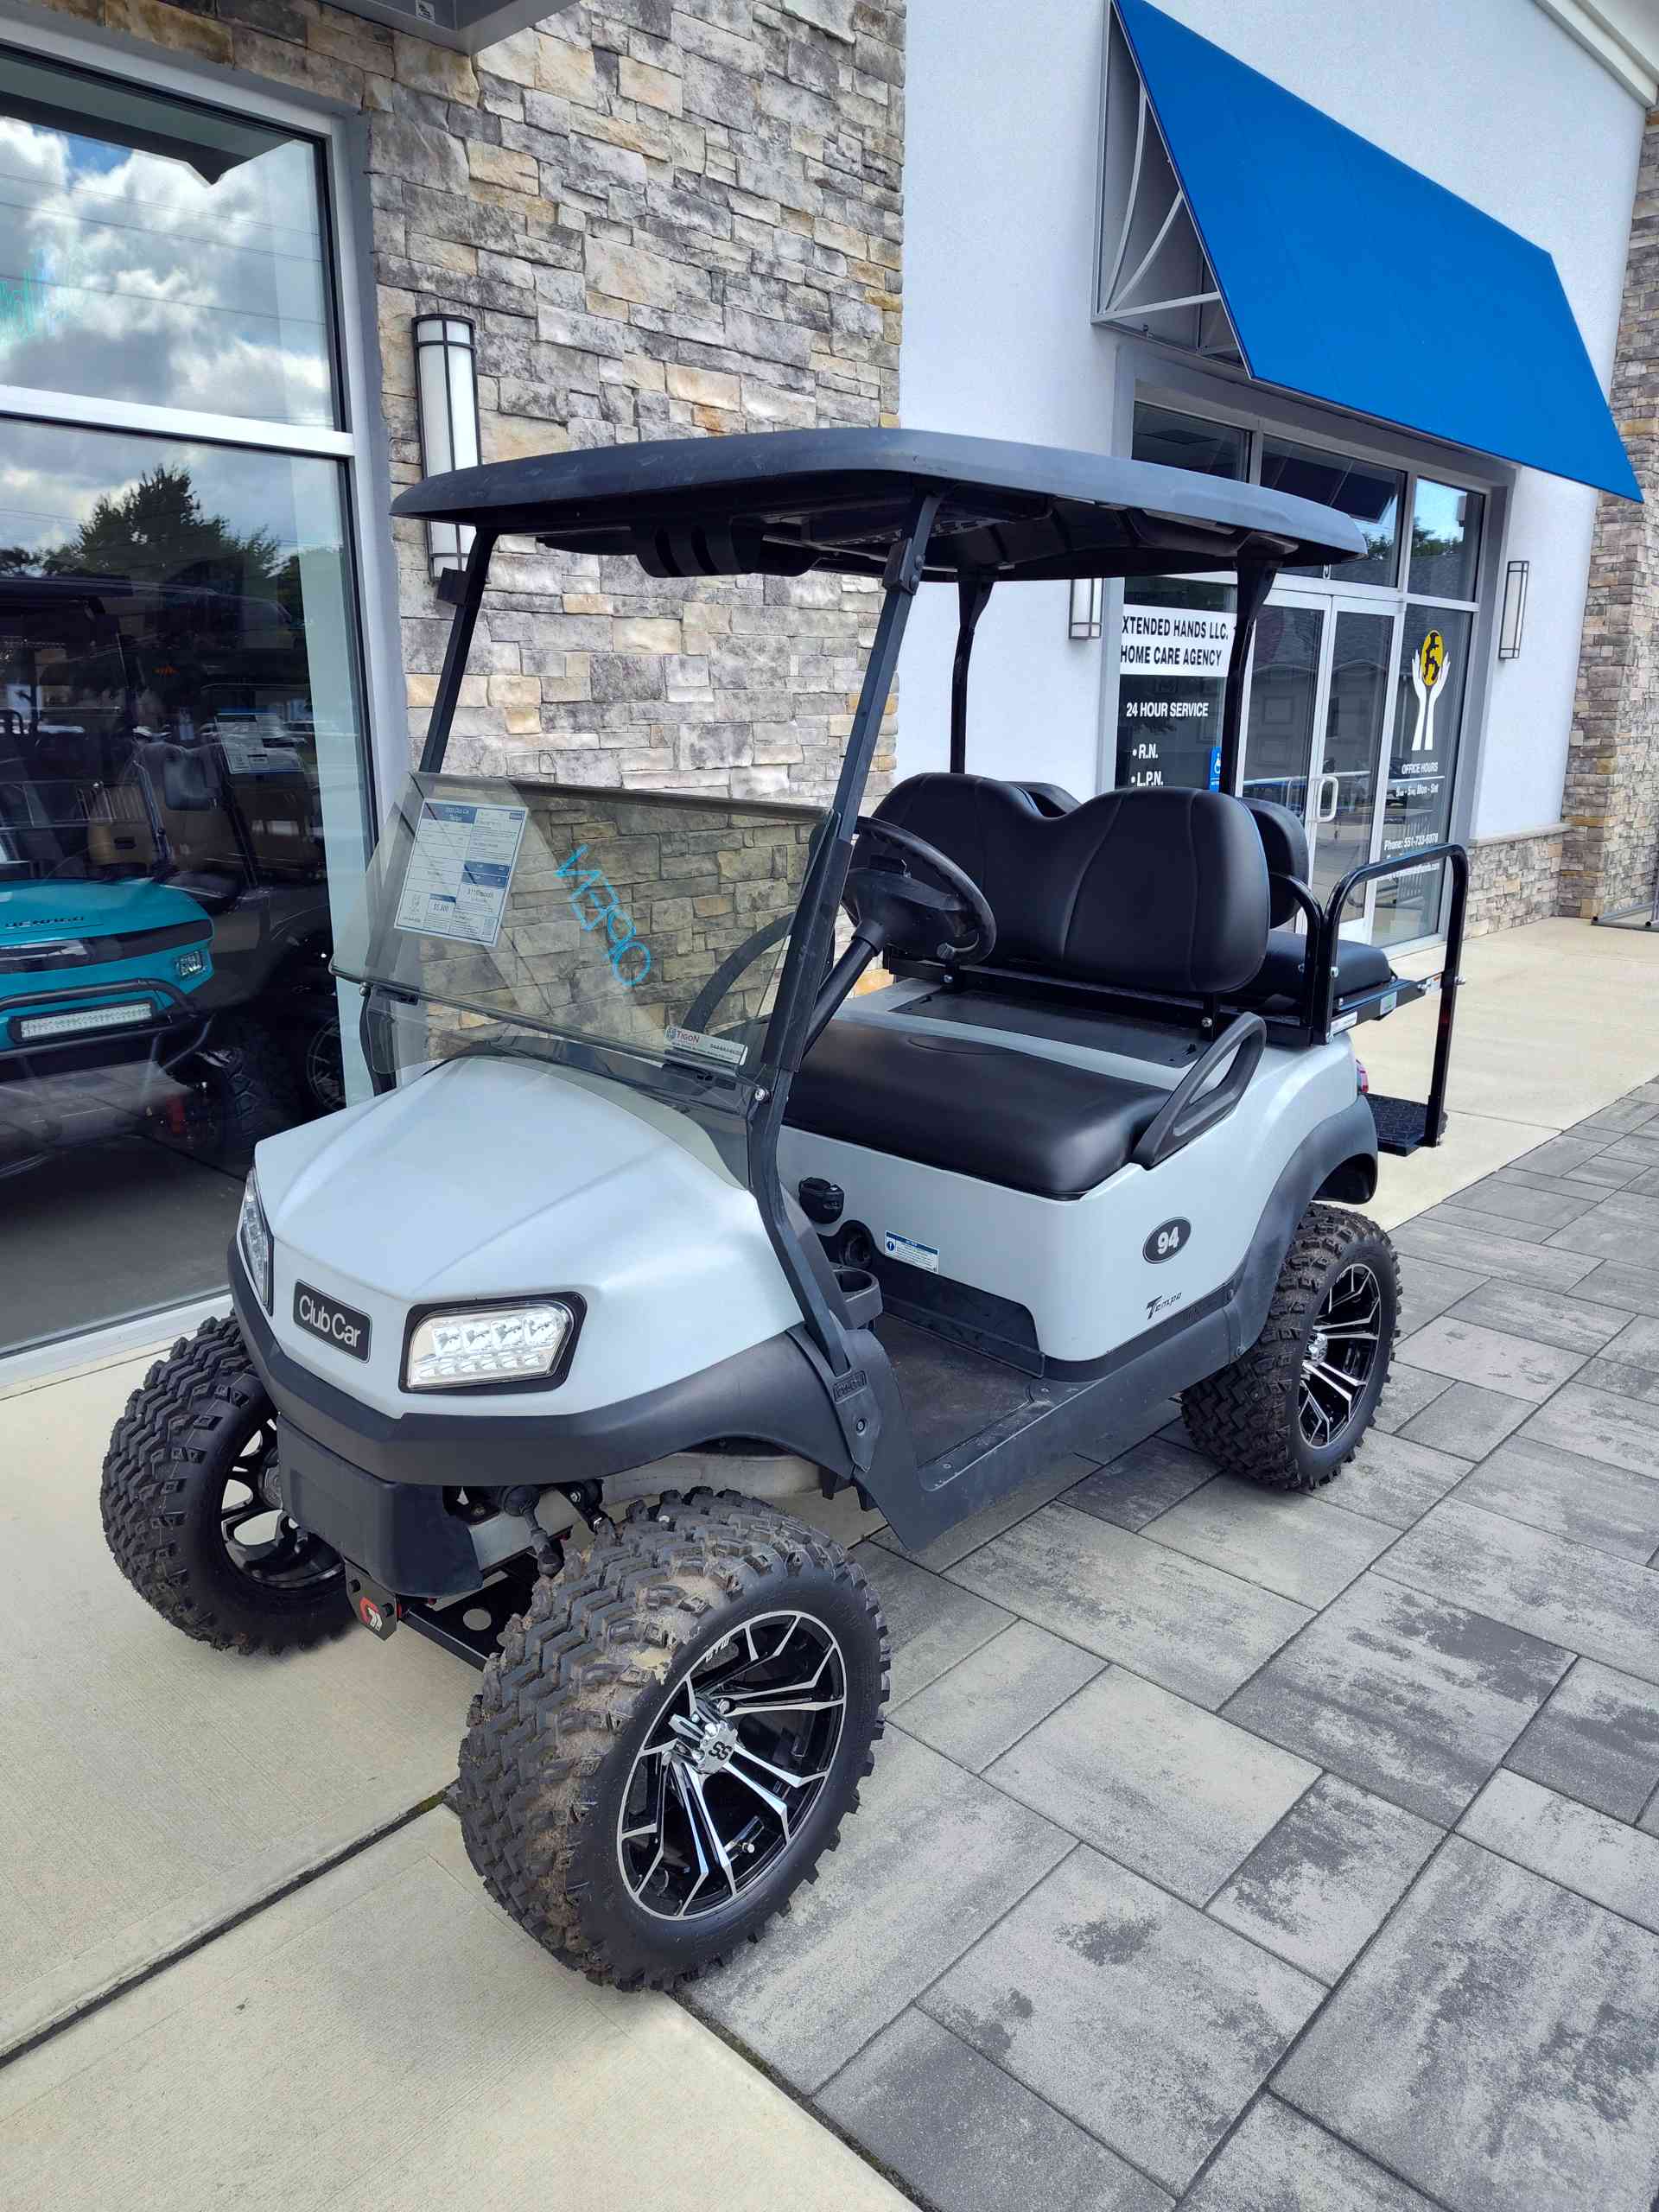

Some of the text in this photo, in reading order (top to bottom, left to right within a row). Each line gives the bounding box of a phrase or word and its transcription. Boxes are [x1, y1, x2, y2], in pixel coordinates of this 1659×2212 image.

[1122, 615, 1171, 636] XTENDED
[1173, 619, 1207, 639] HANDS
[1120, 645, 1223, 666] HOME CARE AGENCY
[1126, 702, 1210, 717] 24 HOUR SERVICE
[1157, 1226, 1179, 1255] 94
[299, 1295, 361, 1348] Club Car
